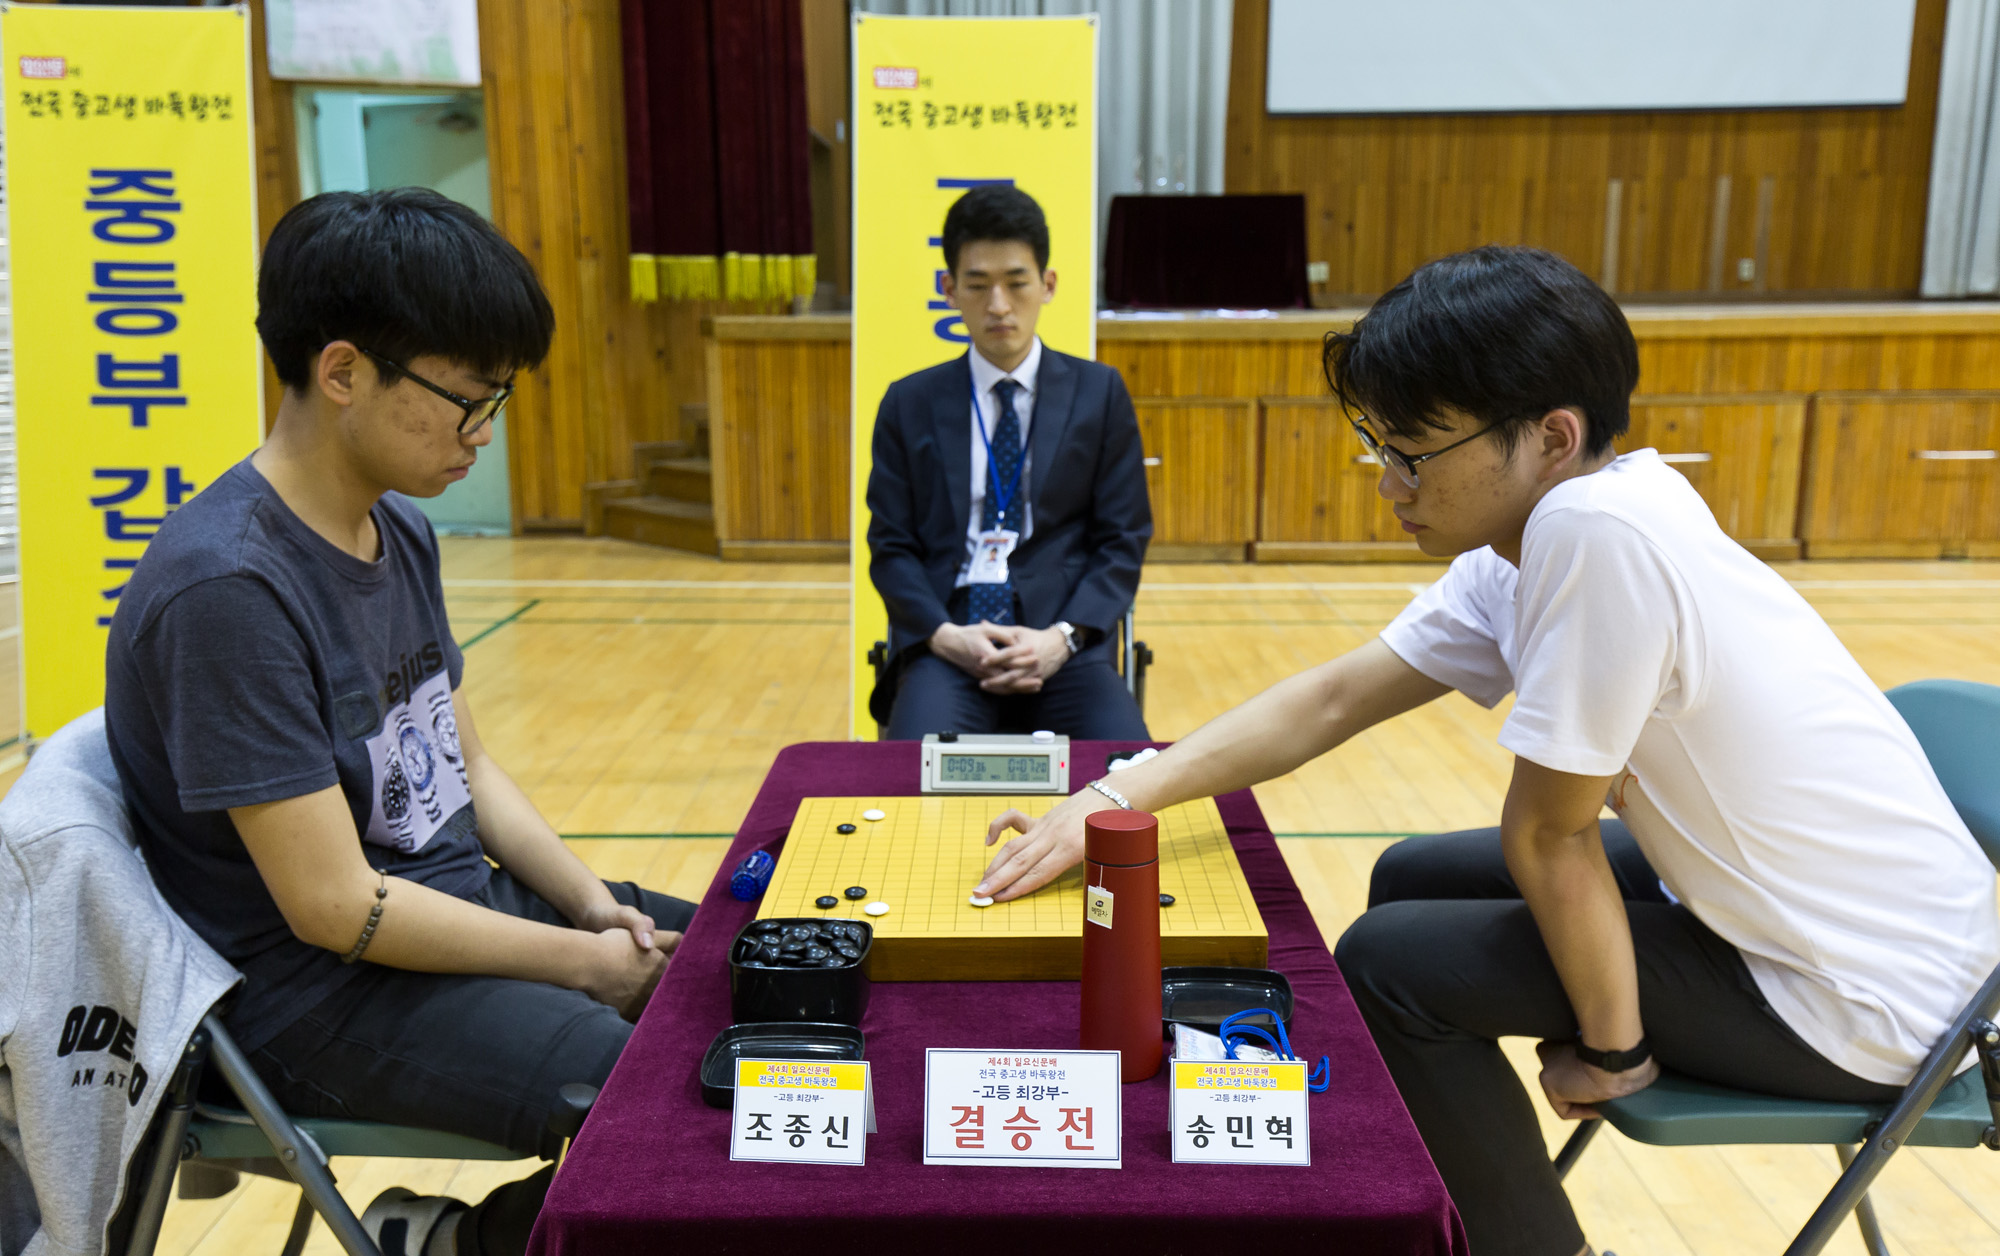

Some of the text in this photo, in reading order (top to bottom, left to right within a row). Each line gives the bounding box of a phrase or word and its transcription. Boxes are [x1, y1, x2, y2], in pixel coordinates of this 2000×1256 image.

[21, 89, 232, 121] 전국 중고생 바둑왕전
[874, 100, 1078, 129] 전국 중고생 바둑왕전
[84, 168, 195, 626] 중등부 갑
[988, 1057, 1058, 1067] 제4회 일요신문배
[767, 1065, 830, 1075] 제4회 일요신문배
[979, 1069, 1066, 1080] 전국 중고생 바둑왕전
[1204, 1066, 1269, 1076] 제4회 일요신문배
[759, 1075, 837, 1087] 전국 중고생 바둑왕전
[1197, 1077, 1277, 1088] 전국 중고생 바둑왕전
